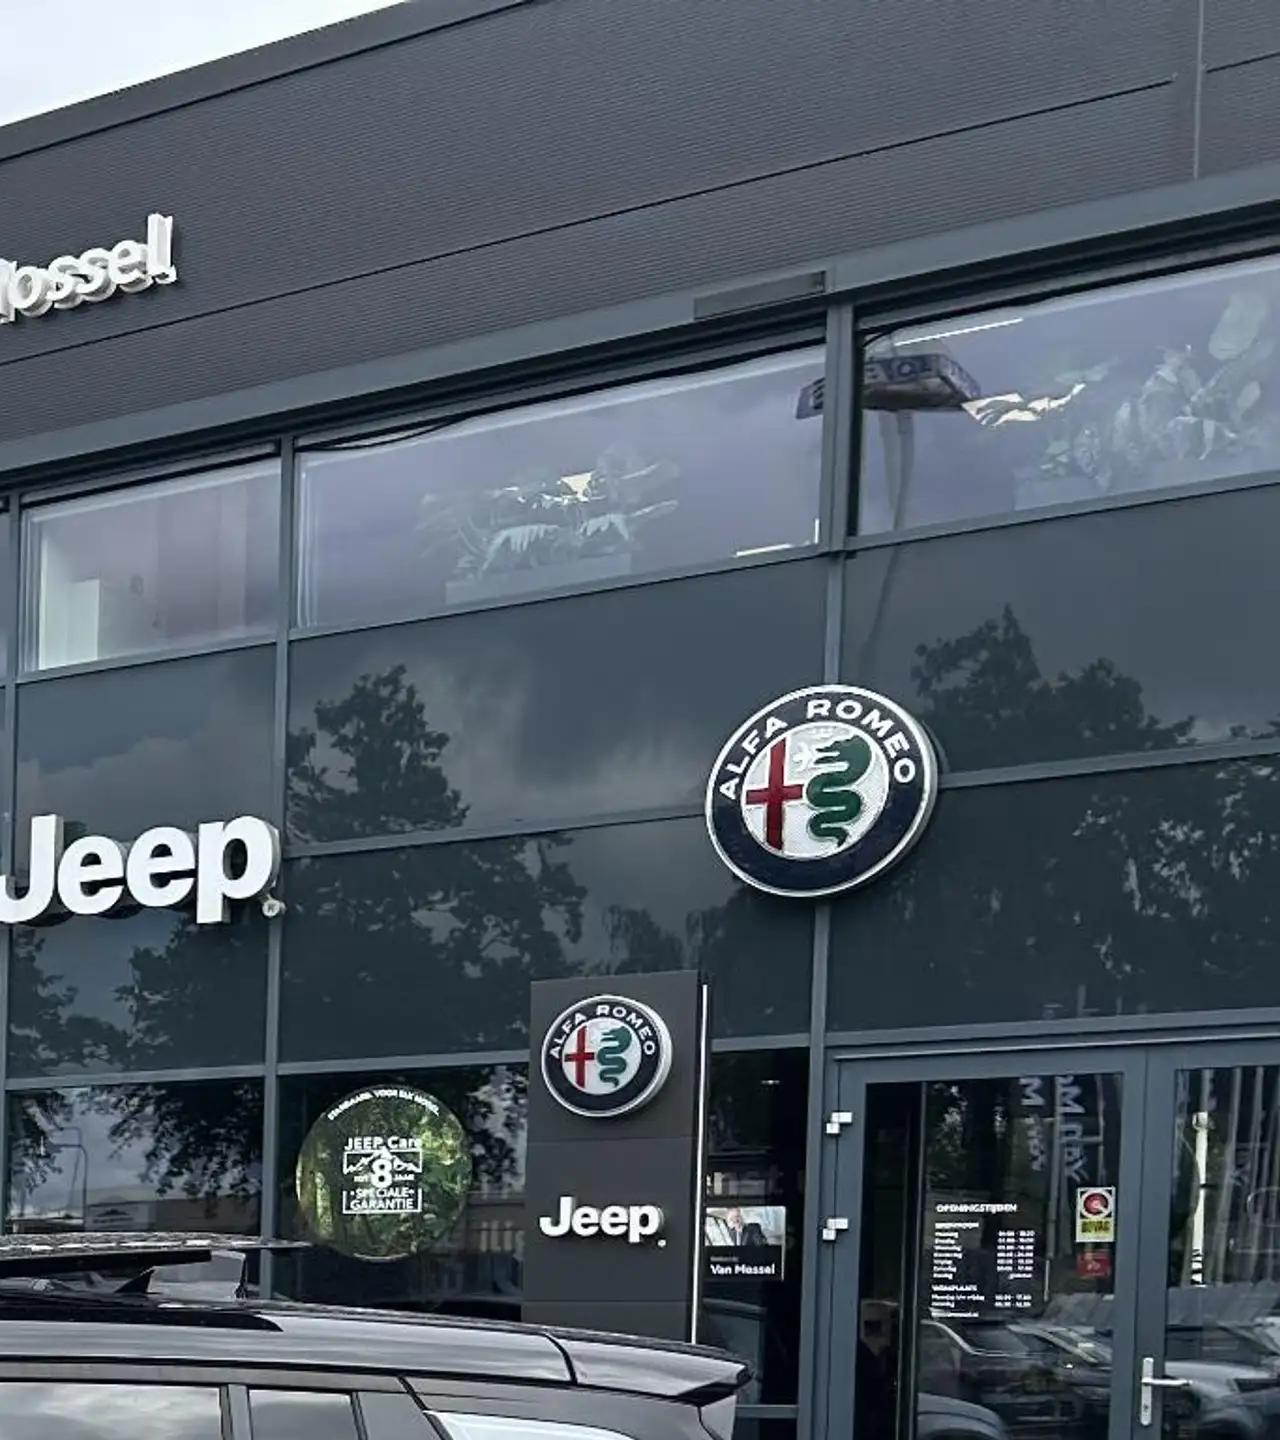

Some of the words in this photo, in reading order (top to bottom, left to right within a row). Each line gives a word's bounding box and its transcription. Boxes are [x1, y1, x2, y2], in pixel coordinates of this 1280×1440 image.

[719, 714, 789, 800] ALFA
[806, 699, 917, 784] ROMEO
[549, 1012, 589, 1060] ALFA
[596, 1004, 657, 1056] ROMEO
[344, 1136, 384, 1151] JEEP
[370, 1158, 393, 1189] 8
[349, 1197, 415, 1211] GARANTIE
[539, 1196, 663, 1244] Jeep
[709, 1263, 732, 1275] Van
[734, 1262, 776, 1275] Mossel
